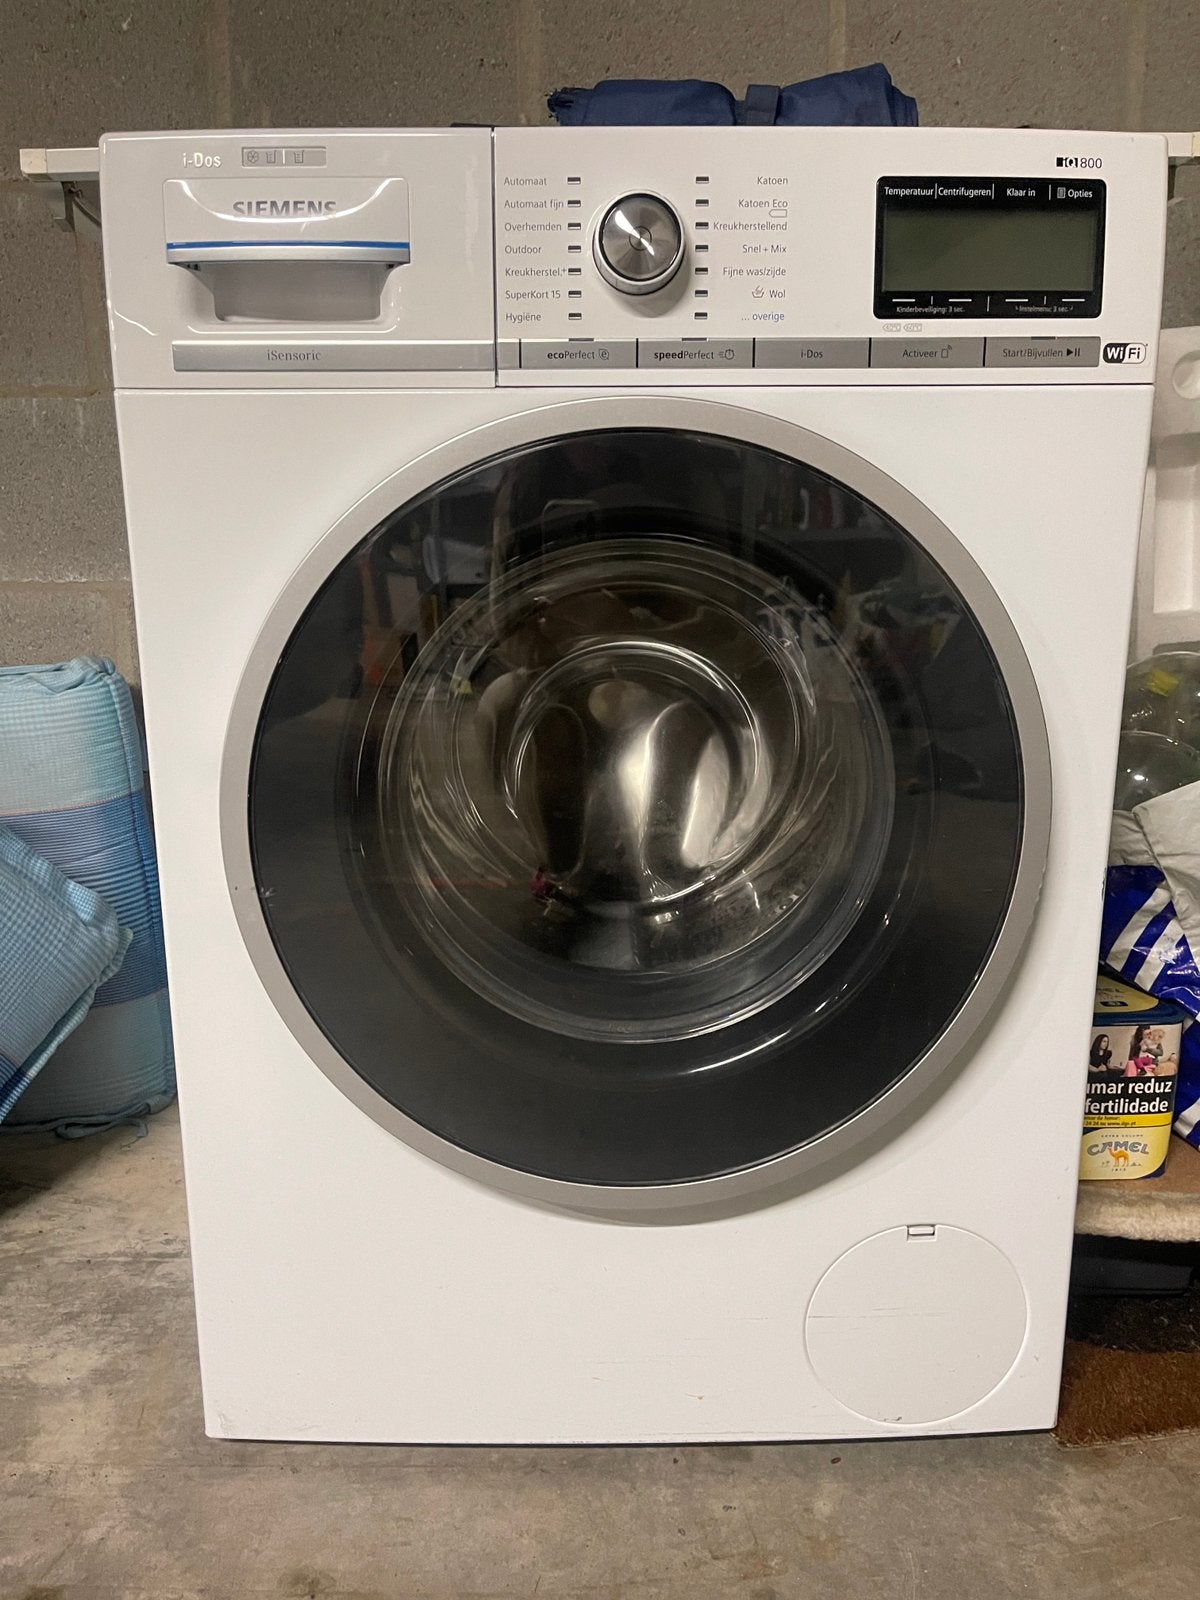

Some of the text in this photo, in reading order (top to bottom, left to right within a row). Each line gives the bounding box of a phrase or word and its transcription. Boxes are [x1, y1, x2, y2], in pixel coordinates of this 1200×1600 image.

[183, 152, 222, 168] i-Dos
[503, 176, 548, 186] Automaat
[757, 176, 789, 185] Katoen
[884, 186, 934, 197] Temperatuur
[938, 186, 992, 198] Centrifugeren
[1006, 188, 1036, 197] Klaar in
[1067, 189, 1093, 199] Opties
[232, 200, 337, 217] SIEMENS
[503, 199, 564, 211] Automaat fijn
[738, 199, 788, 208] Katoen Eco
[504, 222, 562, 231] Overhemden
[713, 221, 788, 231] Kreukherstellend
[504, 245, 542, 254] Outdoor
[742, 244, 761, 254] Snel
[770, 244, 787, 254] Mix
[722, 267, 787, 278] Fijne was/zijde
[505, 290, 561, 300] SuperKort 15
[769, 289, 786, 298] Wol
[505, 312, 542, 323] Hygiëne
[752, 311, 785, 323] overige
[266, 349, 322, 362] iSensoric
[547, 350, 595, 360] ecoPerfect
[654, 349, 714, 362] speedPerfect
[800, 349, 823, 359] i-Dos
[902, 349, 938, 358] Activeer
[1002, 348, 1063, 359] Start/Bijvullen
[1128, 1077, 1173, 1095] reduz
[1085, 1097, 1169, 1114] fertilidade
[1087, 1140, 1150, 1156] CAMEL
